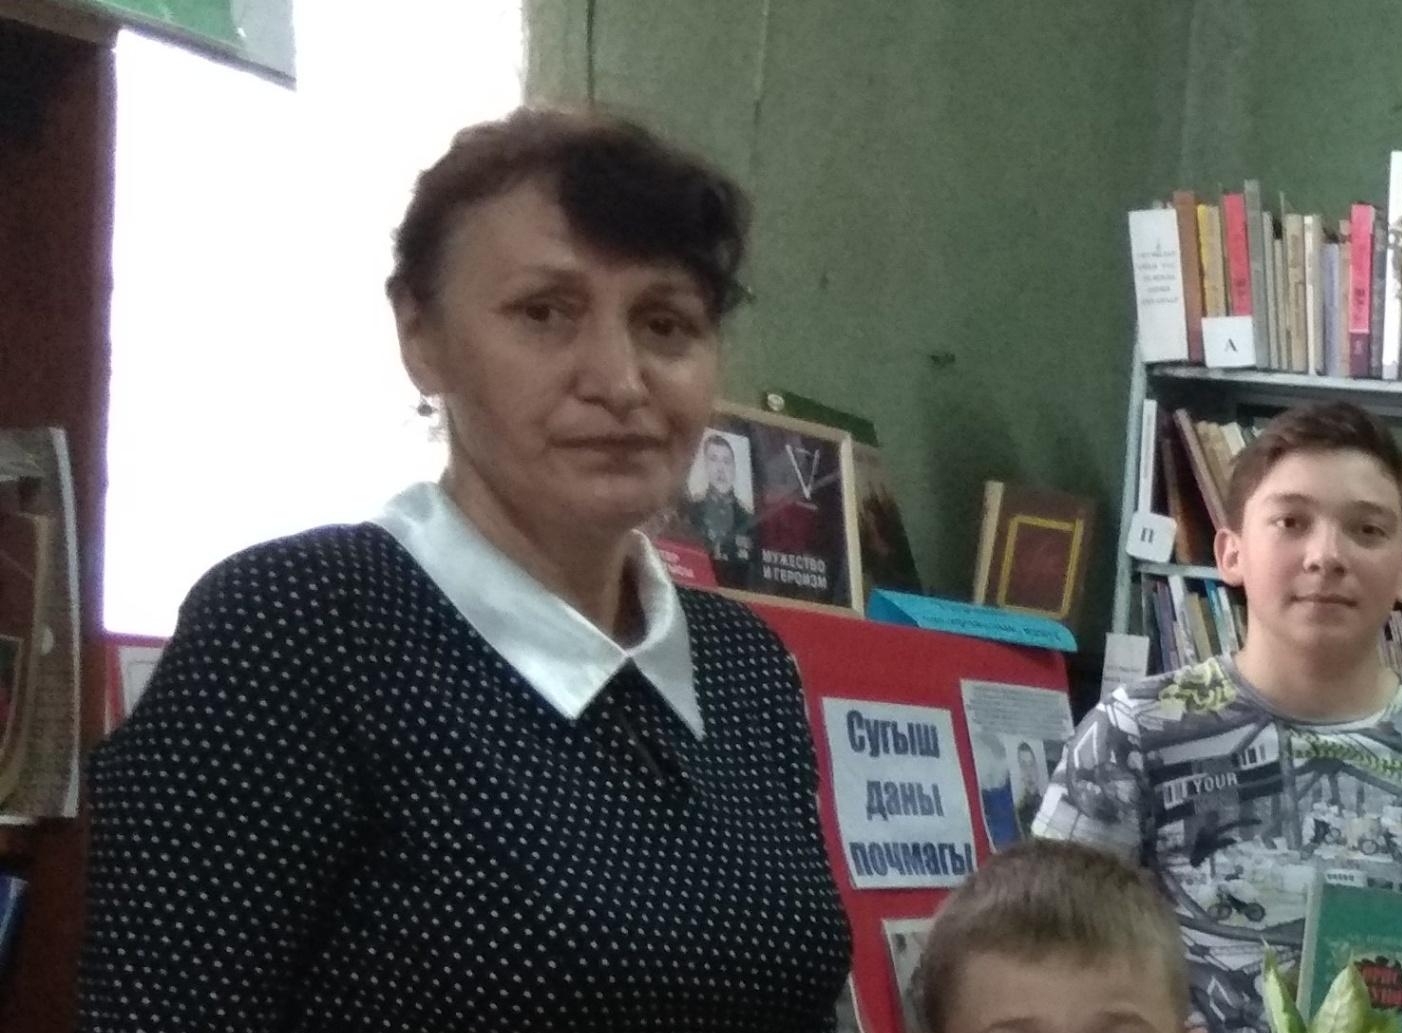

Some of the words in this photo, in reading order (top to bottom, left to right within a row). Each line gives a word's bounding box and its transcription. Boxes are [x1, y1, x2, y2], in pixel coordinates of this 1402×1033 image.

[1139, 525, 1155, 544] П
[762, 550, 826, 573] МУЖЕСТВО
[773, 568, 827, 590] ГЕРОИЗМ
[846, 709, 941, 759] Сугыш
[1193, 771, 1238, 793] YOUR
[866, 780, 945, 822] даны
[848, 841, 975, 877] почмагы
